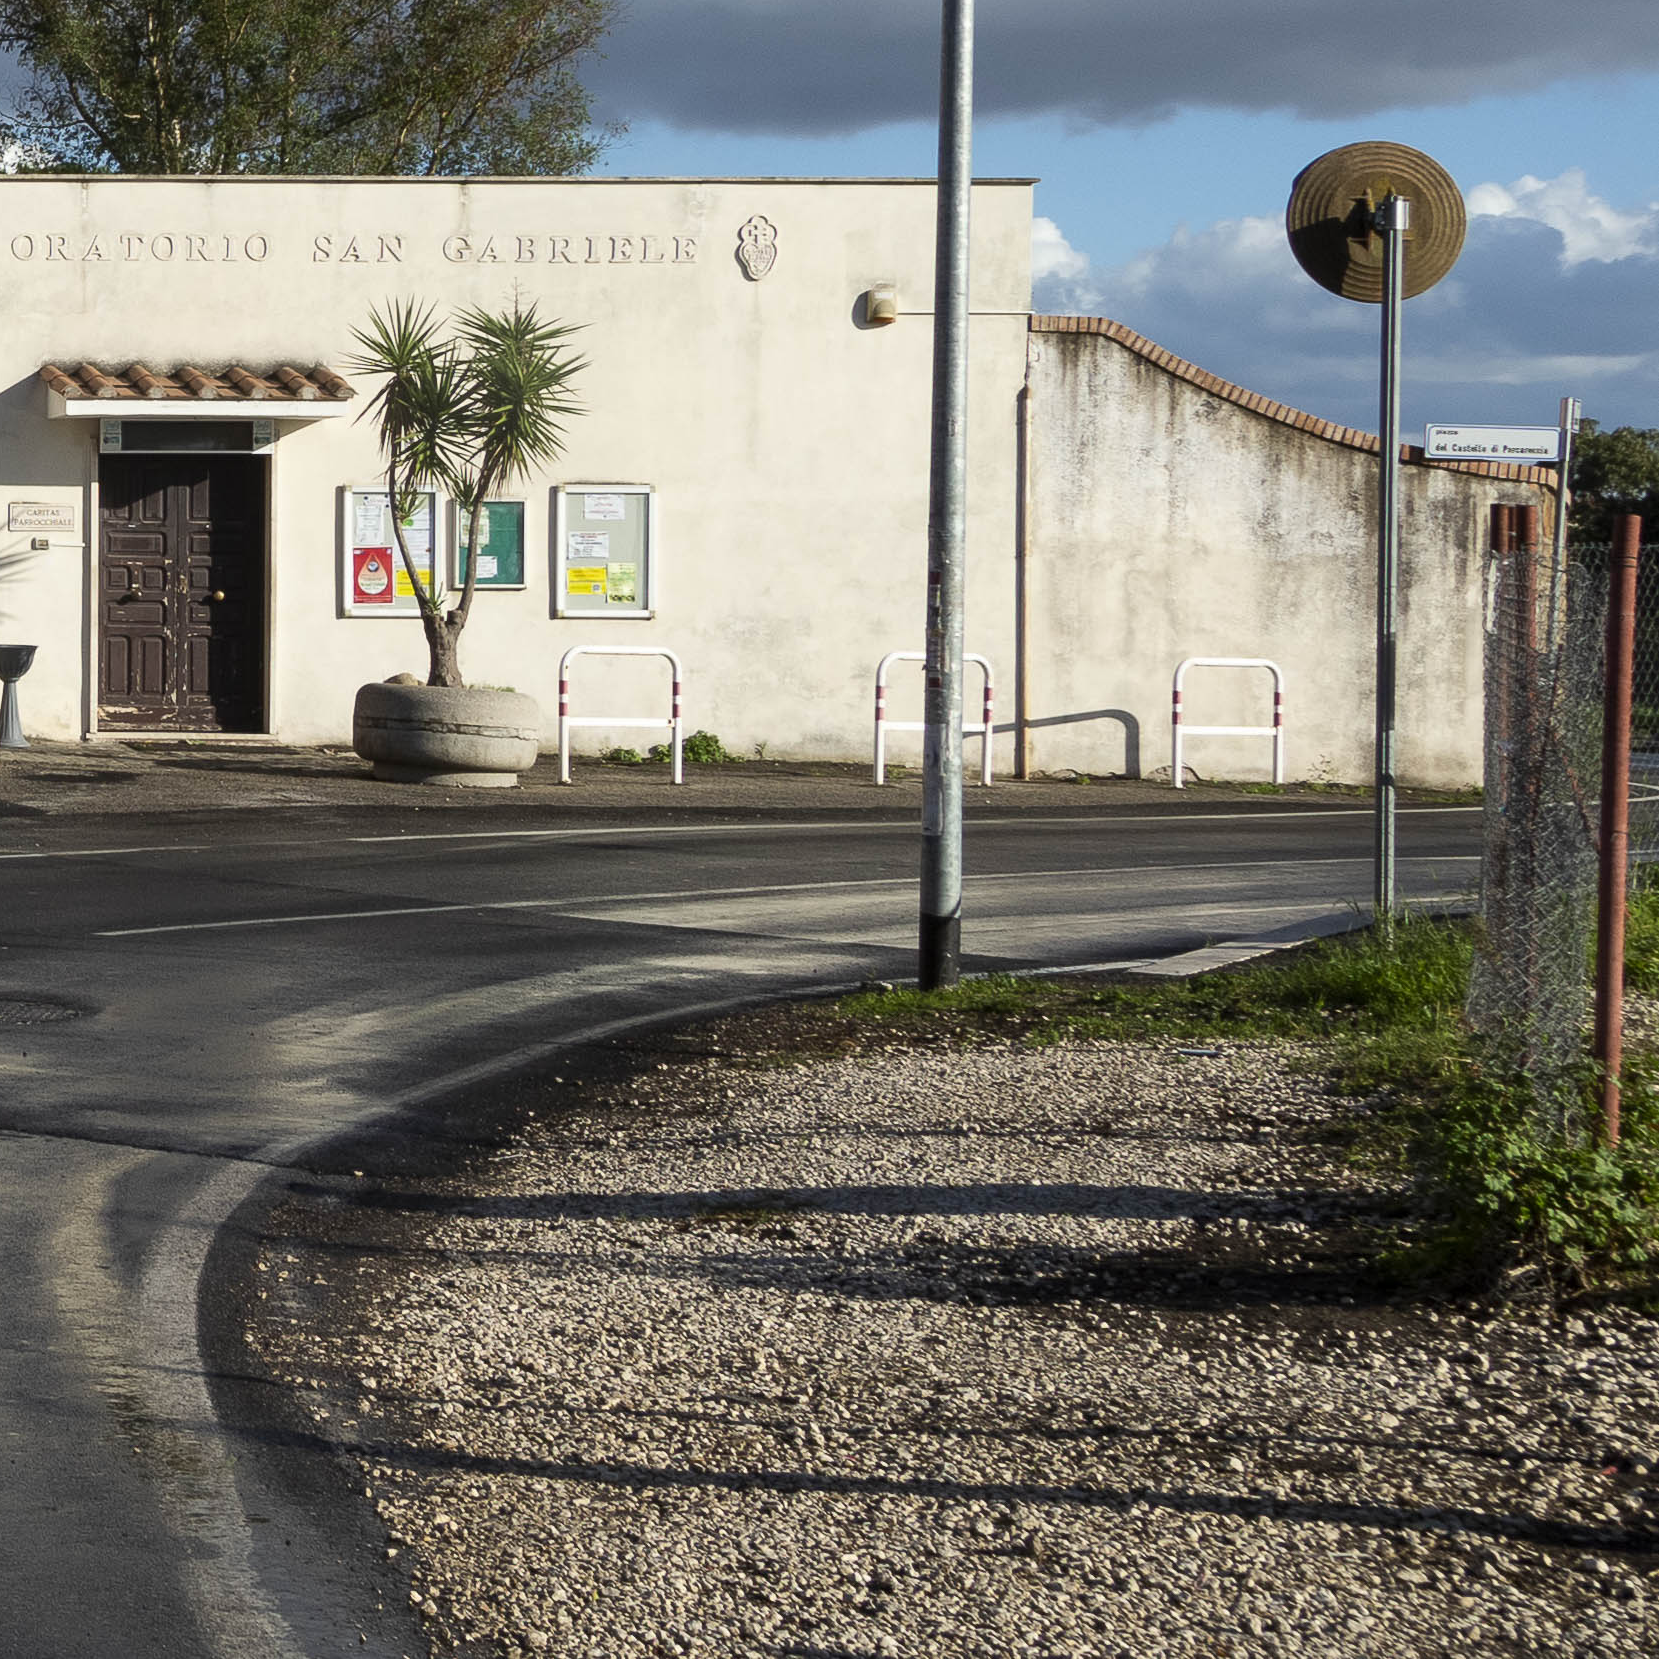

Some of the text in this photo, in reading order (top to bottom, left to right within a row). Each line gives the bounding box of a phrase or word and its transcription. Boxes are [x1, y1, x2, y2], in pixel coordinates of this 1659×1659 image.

[9, 233, 699, 264] ORATORIO SAN GABRIELE
[1435, 443, 1447, 452] del
[1451, 443, 1487, 453] Castello
[1490, 444, 1499, 453] di
[26, 508, 60, 516] CARITAS
